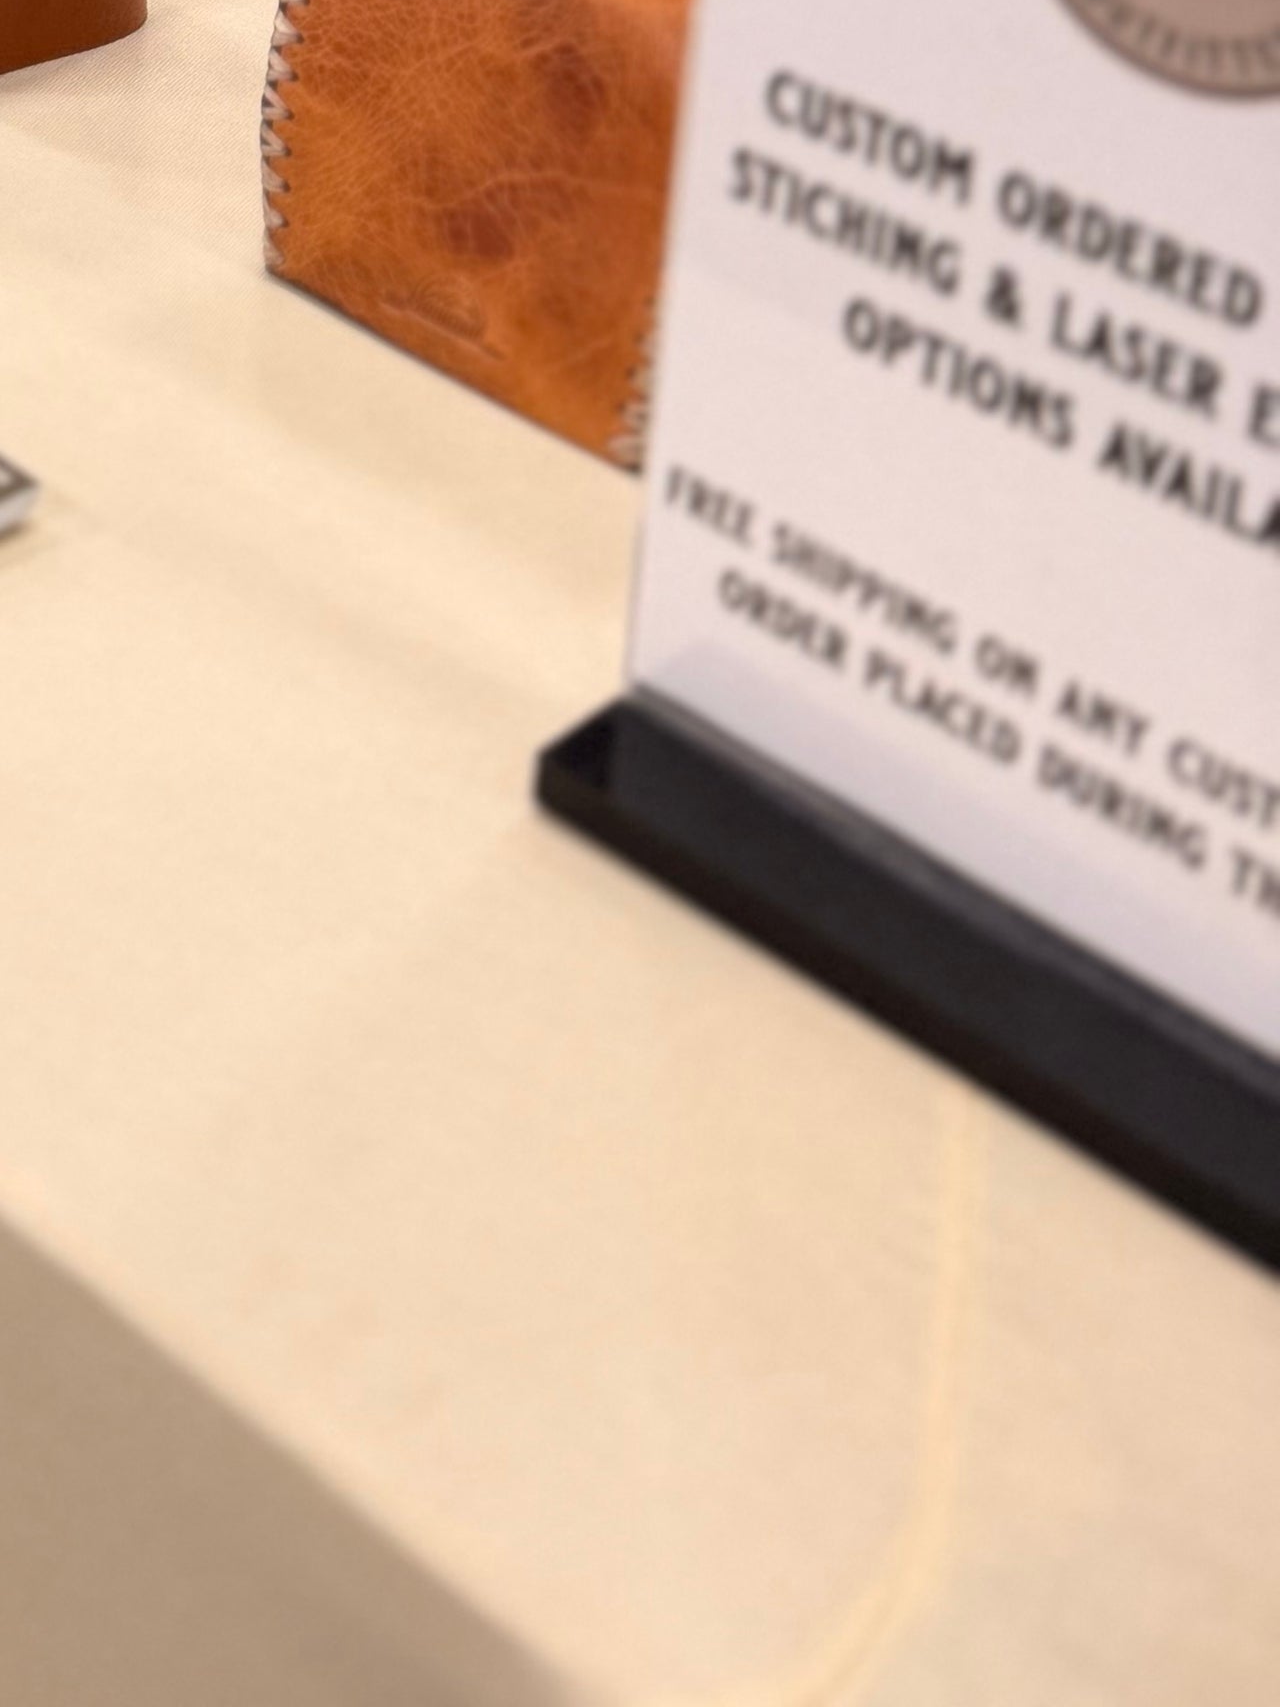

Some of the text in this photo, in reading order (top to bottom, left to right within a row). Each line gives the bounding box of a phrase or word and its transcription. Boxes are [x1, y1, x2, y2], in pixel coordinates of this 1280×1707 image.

[729, 145, 961, 296] STICHING
[984, 266, 1021, 327] &
[1050, 292, 1225, 416] LASER
[765, 69, 1263, 327] CUSTOM ORDERED
[842, 296, 1075, 450] OPTIONS
[665, 464, 757, 547] FREE
[771, 522, 958, 655] SHIPPING
[975, 632, 1042, 697] ON
[1056, 681, 1151, 755] ANY
[718, 568, 846, 670] ORDER
[864, 649, 1023, 765] PLACED
[1038, 744, 1208, 870] DURING
